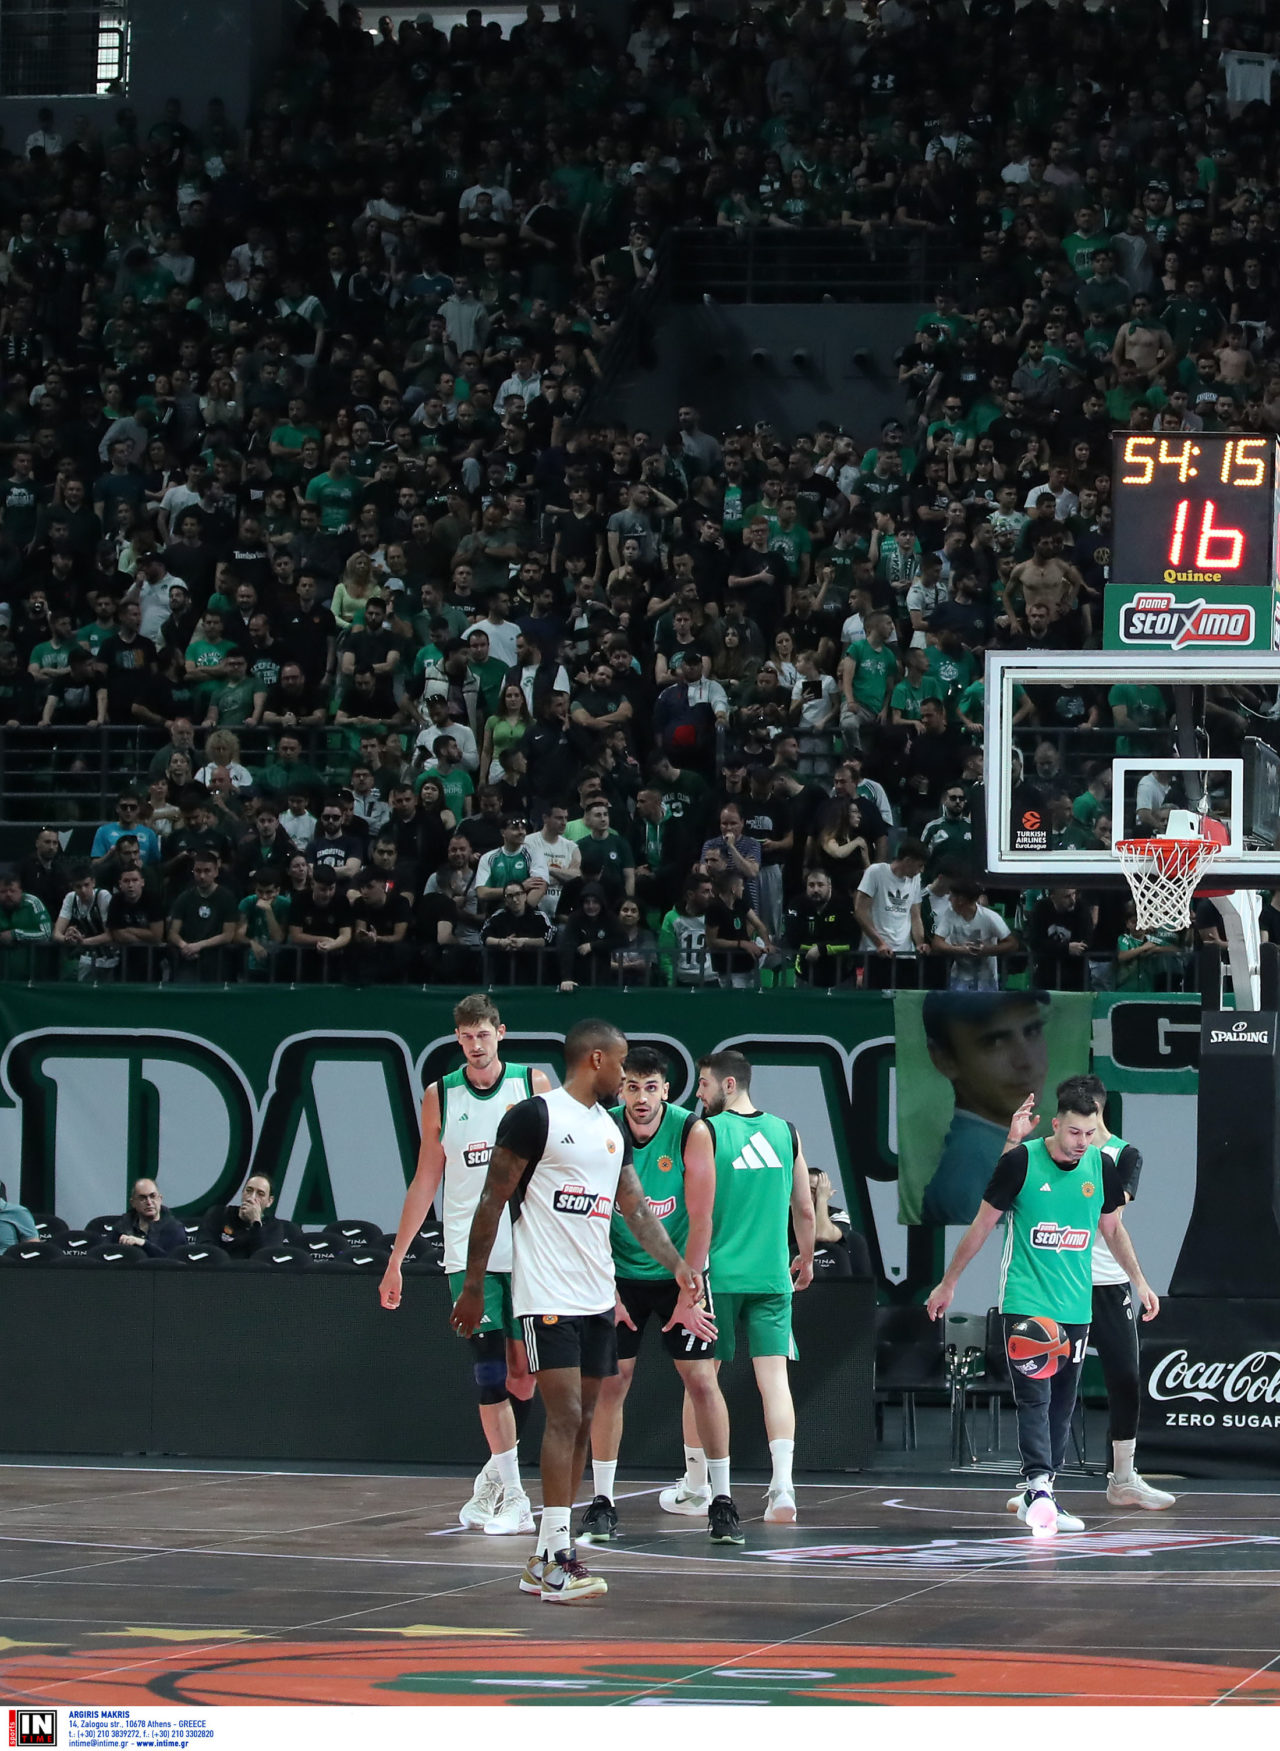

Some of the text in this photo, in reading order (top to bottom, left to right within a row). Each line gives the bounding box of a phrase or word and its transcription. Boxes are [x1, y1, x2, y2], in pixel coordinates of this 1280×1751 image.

[1220, 438, 1266, 486] 15
[1168, 499, 1245, 569] 16
[1163, 569, 1222, 584] Quince
[1137, 598, 1168, 610] pame
[1210, 1030, 1269, 1044] SPALDING
[1166, 1413, 1216, 1427] ZERO
